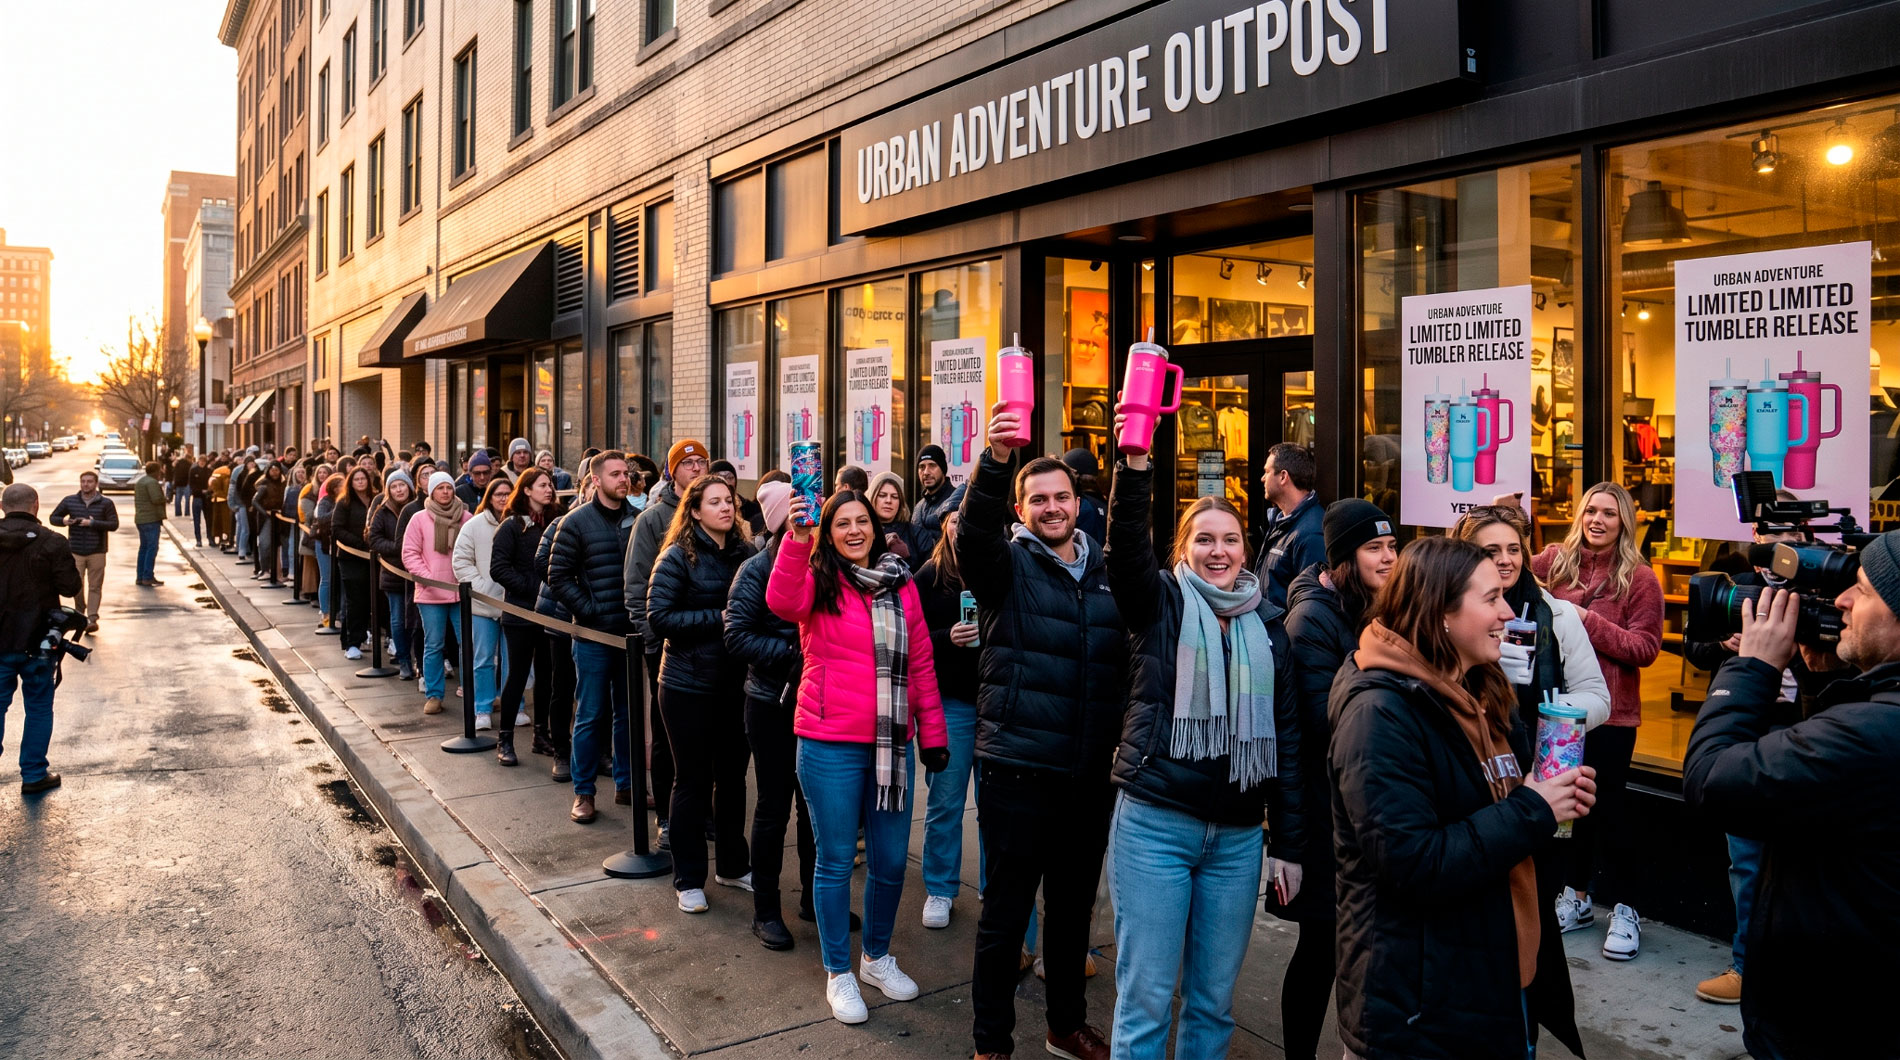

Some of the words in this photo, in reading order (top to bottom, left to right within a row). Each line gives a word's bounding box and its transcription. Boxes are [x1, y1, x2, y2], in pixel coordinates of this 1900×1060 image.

[858, 120, 941, 204] URBAN
[949, 44, 1151, 178] ADVENTURE
[1164, 0, 1388, 113] OUTPOST
[1713, 271, 1751, 287] URBAN
[1754, 264, 1824, 283] ADVENTURE
[1428, 307, 1454, 319] URBAN
[1456, 303, 1503, 318] ADVENTURE
[1688, 290, 1763, 317] LIMITED
[1769, 282, 1854, 311] LIMITED
[1410, 323, 1461, 344] LIMITED
[1465, 318, 1521, 340] LIMITED
[1685, 317, 1768, 342] TUMBLER
[1773, 311, 1859, 338] RELEASE
[1408, 345, 1465, 365] TUMBLER
[1468, 341, 1525, 362] RELEASE
[1450, 502, 1477, 514] YET
